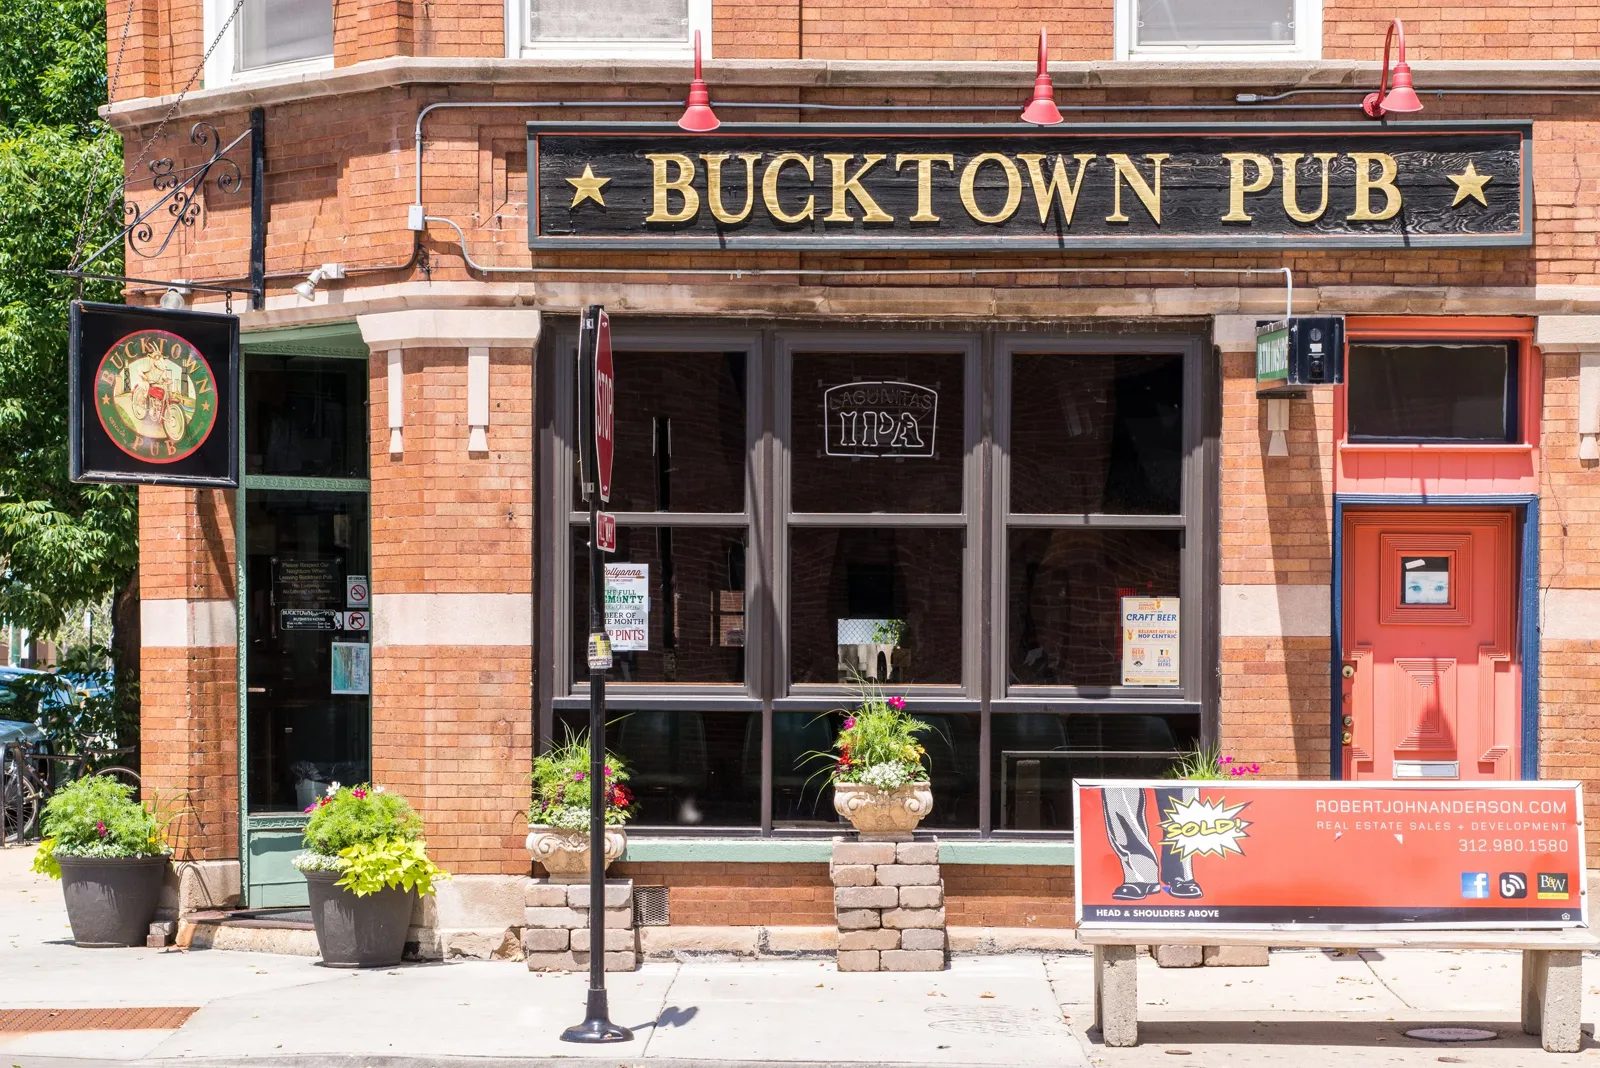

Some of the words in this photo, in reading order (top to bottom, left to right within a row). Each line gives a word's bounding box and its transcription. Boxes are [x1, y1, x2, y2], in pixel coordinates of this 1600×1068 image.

[645, 152, 1170, 225] BUCKTOWN
[1221, 152, 1402, 223] PUB
[101, 337, 212, 395] BUCKTOWN
[597, 369, 613, 440] STOP
[840, 411, 924, 447] IPA
[131, 435, 177, 456] PUB
[1126, 613, 1155, 621] CRAFT
[1157, 613, 1177, 621] BEER
[615, 630, 645, 640] PINTS
[1316, 800, 1567, 814] ROBERTJOHNANDERSON.COM
[1166, 818, 1242, 839] SOLD!
[1316, 821, 1349, 830] REAL
[1355, 821, 1403, 830] ESTATE
[1410, 822, 1451, 831] SALES
[1471, 822, 1567, 831] DEVELOPMENT
[1458, 839, 1568, 852] 312.980.1580
[1096, 909, 1121, 917] HEAD
[1124, 909, 1130, 917] &
[1133, 909, 1185, 917] SHOULDERS
